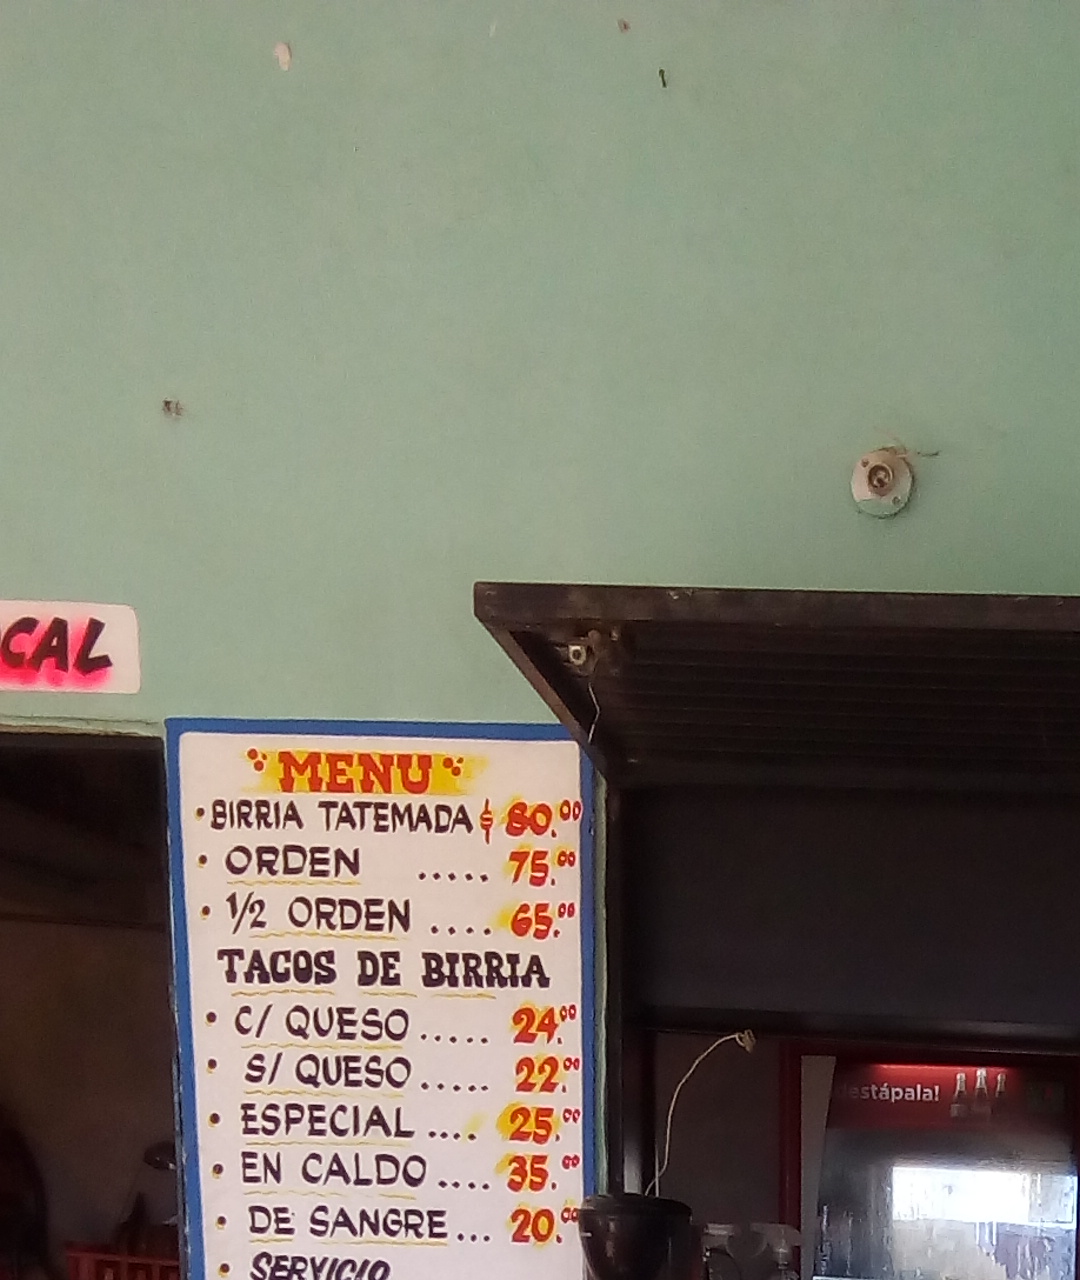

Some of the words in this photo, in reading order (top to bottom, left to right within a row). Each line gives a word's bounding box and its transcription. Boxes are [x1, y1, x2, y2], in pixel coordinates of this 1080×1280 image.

[277, 751, 432, 794] MENU
[210, 799, 304, 831] BIRRIA
[318, 801, 474, 834] TATEMADA
[225, 845, 361, 877] ORDEN
[287, 896, 411, 932] ORDEN
[217, 948, 337, 986] TACOS
[358, 950, 401, 987] DE
[421, 951, 550, 988] BIRRIA
[234, 1004, 273, 1038] C/
[285, 1006, 410, 1041] QUESO
[244, 1052, 283, 1085] S/
[295, 1054, 412, 1088] QUESO
[241, 1103, 416, 1139] ESPECIAL
[242, 1151, 282, 1184] EN
[301, 1152, 427, 1187] CALDO
[248, 1205, 295, 1235] DE
[309, 1206, 449, 1239] SANGRE
